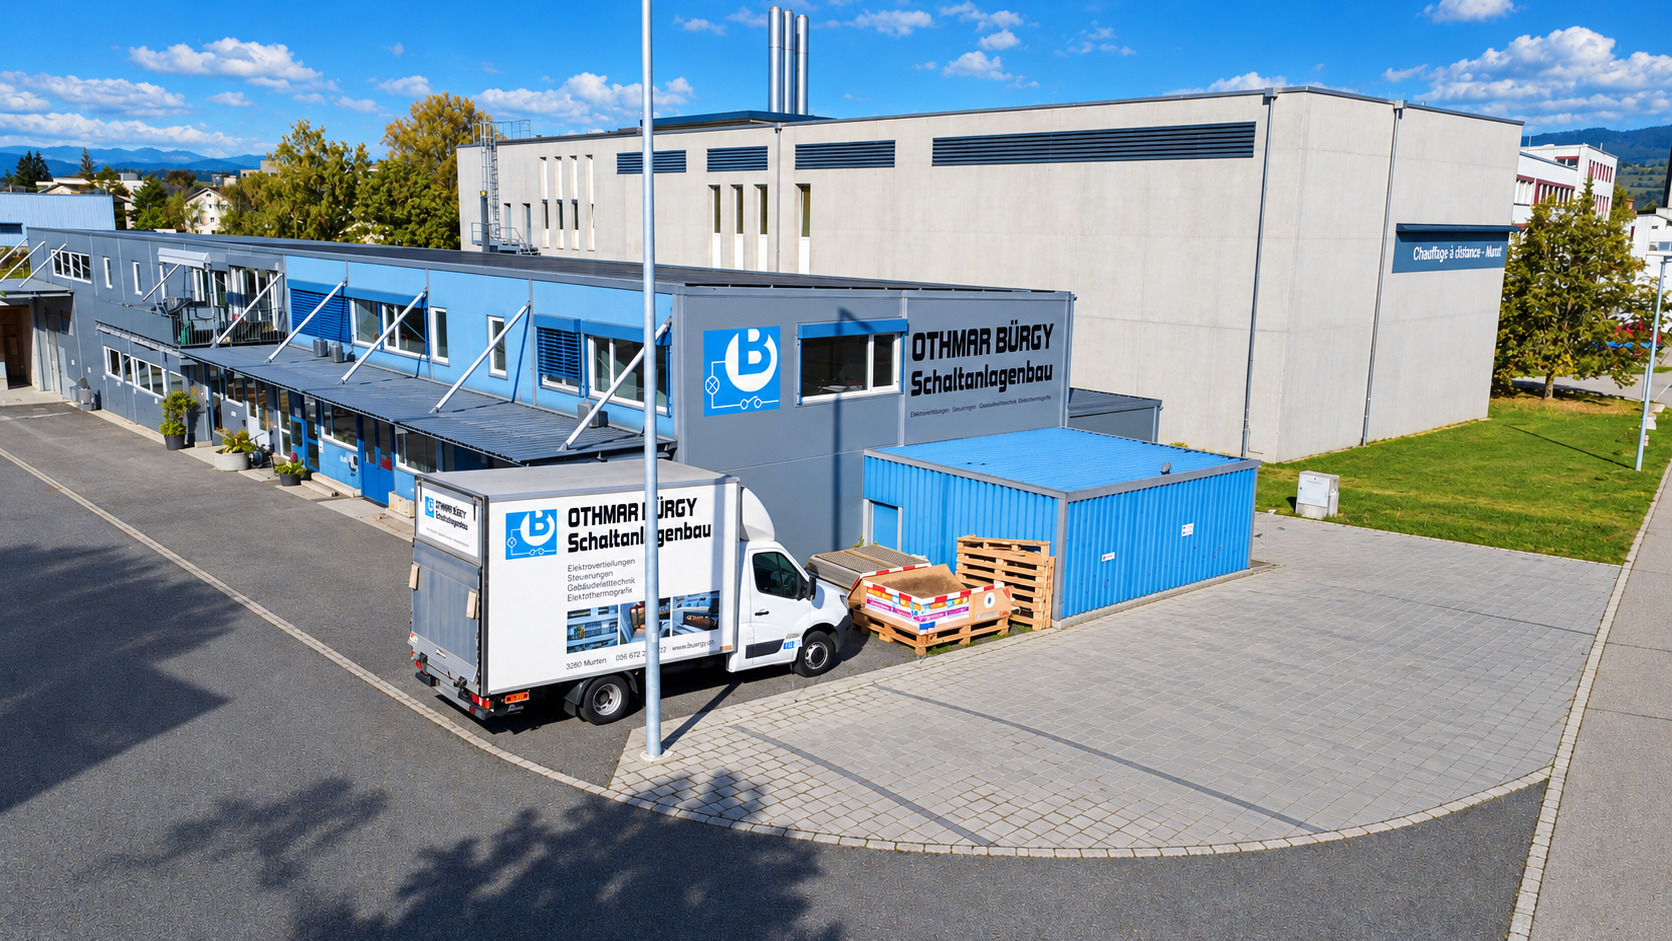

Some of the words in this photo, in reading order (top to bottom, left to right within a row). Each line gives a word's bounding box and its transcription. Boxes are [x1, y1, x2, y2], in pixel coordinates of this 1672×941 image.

[1413, 245, 1449, 263] Chauffage
[1449, 245, 1454, 259] à
[1455, 245, 1481, 258] distance
[912, 328, 991, 361] OTHMAR
[996, 320, 1054, 353] BÜRGY
[911, 362, 1053, 396] Schaltanlagenbau
[568, 502, 639, 528] OTHMAR
[568, 522, 711, 553] Schaltanlgenbau
[567, 570, 614, 582] Steuerungen
[583, 657, 607, 666] Murten
[629, 650, 641, 659] 672
